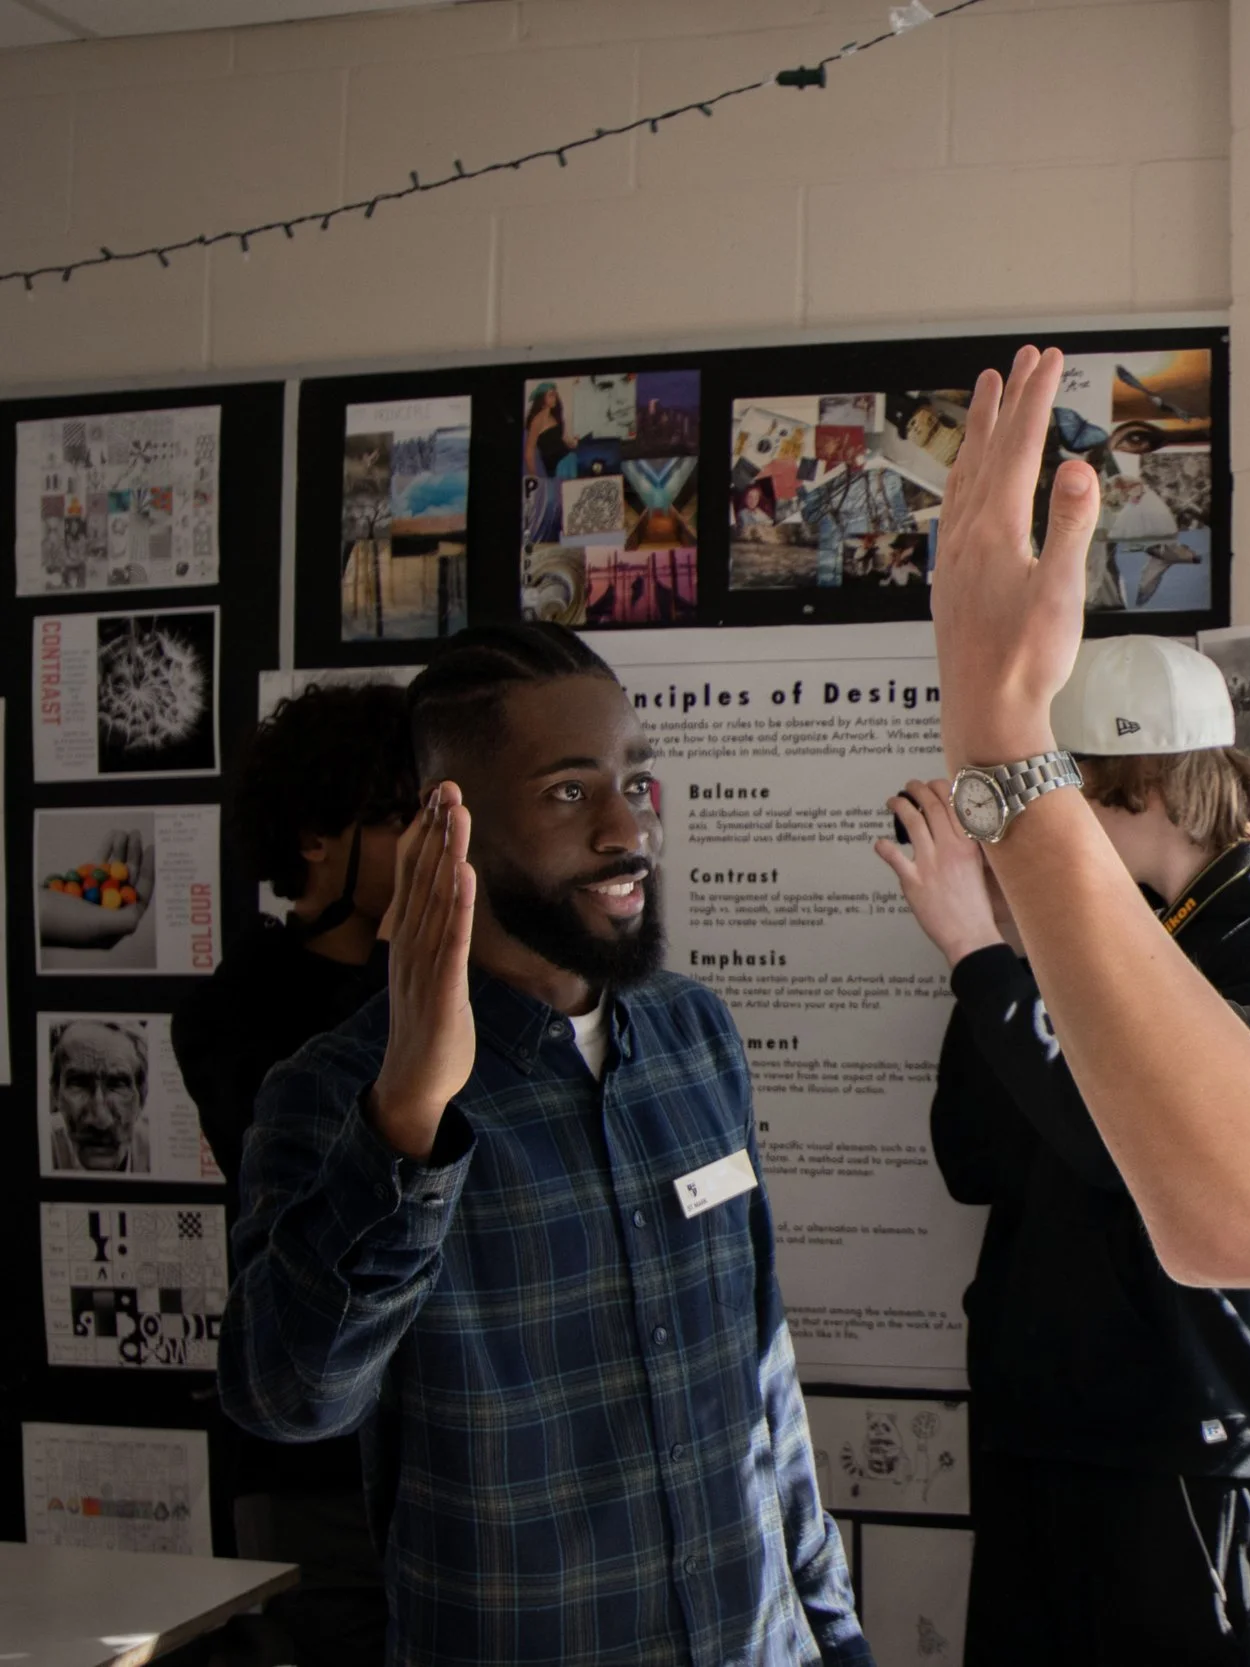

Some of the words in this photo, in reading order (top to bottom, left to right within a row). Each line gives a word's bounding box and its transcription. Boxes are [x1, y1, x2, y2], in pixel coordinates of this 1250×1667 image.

[42, 621, 62, 726] CONTRAST
[771, 681, 802, 704] of
[823, 678, 940, 709] Design
[660, 719, 709, 729] standards
[726, 718, 752, 728] rules
[754, 719, 765, 727] to
[767, 717, 782, 727] be
[784, 716, 835, 726] observed
[836, 716, 851, 728] by
[854, 715, 888, 725] Artists
[890, 715, 901, 724] in
[683, 733, 704, 742] how
[707, 733, 718, 742] to
[721, 733, 754, 741] create
[757, 731, 778, 741] and
[781, 730, 828, 743] organize
[887, 729, 919, 738] When
[668, 747, 684, 756] the
[687, 746, 736, 759] principles
[739, 746, 749, 755] in
[752, 745, 780, 756] mind,
[784, 744, 846, 757] outstanding
[849, 743, 893, 753] Artwork
[688, 782, 771, 798] Balance
[689, 808, 695, 817] A
[699, 807, 750, 817] distribution
[753, 807, 762, 816] of
[766, 807, 792, 816] visual
[796, 806, 826, 819] weight
[845, 806, 872, 815] either
[716, 819, 772, 832] Symmetrical
[775, 819, 813, 828] balance
[840, 818, 855, 828] the
[688, 832, 750, 845] Asymmetrical
[776, 832, 816, 841] different
[818, 831, 834, 841] but
[837, 831, 873, 844] equally
[688, 867, 779, 882] Contrast
[690, 891, 705, 900] The
[708, 892, 768, 903] arrangement
[770, 891, 780, 900] of
[783, 891, 824, 903] opposite
[827, 891, 868, 900] elements
[689, 903, 716, 916] rough
[734, 903, 772, 914] smooth,
[773, 903, 799, 912] small
[875, 903, 886, 912] in
[191, 883, 213, 969] COLOUR
[715, 917, 724, 925] to
[728, 917, 756, 925] create
[761, 916, 786, 925] visual
[688, 950, 788, 969] Emphasis
[714, 973, 726, 982] to
[727, 972, 753, 982] make
[755, 973, 789, 982] certain
[790, 974, 816, 985] parts
[817, 973, 828, 982] of
[845, 973, 885, 982] Artwork
[887, 973, 916, 983] stand
[938, 974, 950, 983] It
[725, 985, 739, 994] the
[743, 986, 771, 994] center
[774, 985, 784, 995] of
[786, 986, 821, 995] interest
[837, 986, 861, 995] focal
[894, 986, 901, 995] It
[914, 986, 929, 996] the
[745, 998, 770, 1007] Artist
[772, 998, 801, 1008] draws
[804, 1002, 825, 1011] your
[828, 1002, 845, 1011] eye
[848, 1000, 858, 1008] to
[783, 1058, 820, 1070] through
[822, 1058, 837, 1068] the
[764, 1069, 794, 1079] viewer
[796, 1070, 818, 1079] from
[842, 1072, 873, 1083] aspect
[876, 1071, 886, 1080] of
[888, 1071, 904, 1081] the
[908, 1072, 932, 1081] work
[757, 1083, 786, 1092] create
[789, 1082, 804, 1092] the
[807, 1083, 839, 1092] illusion
[842, 1083, 852, 1092] of
